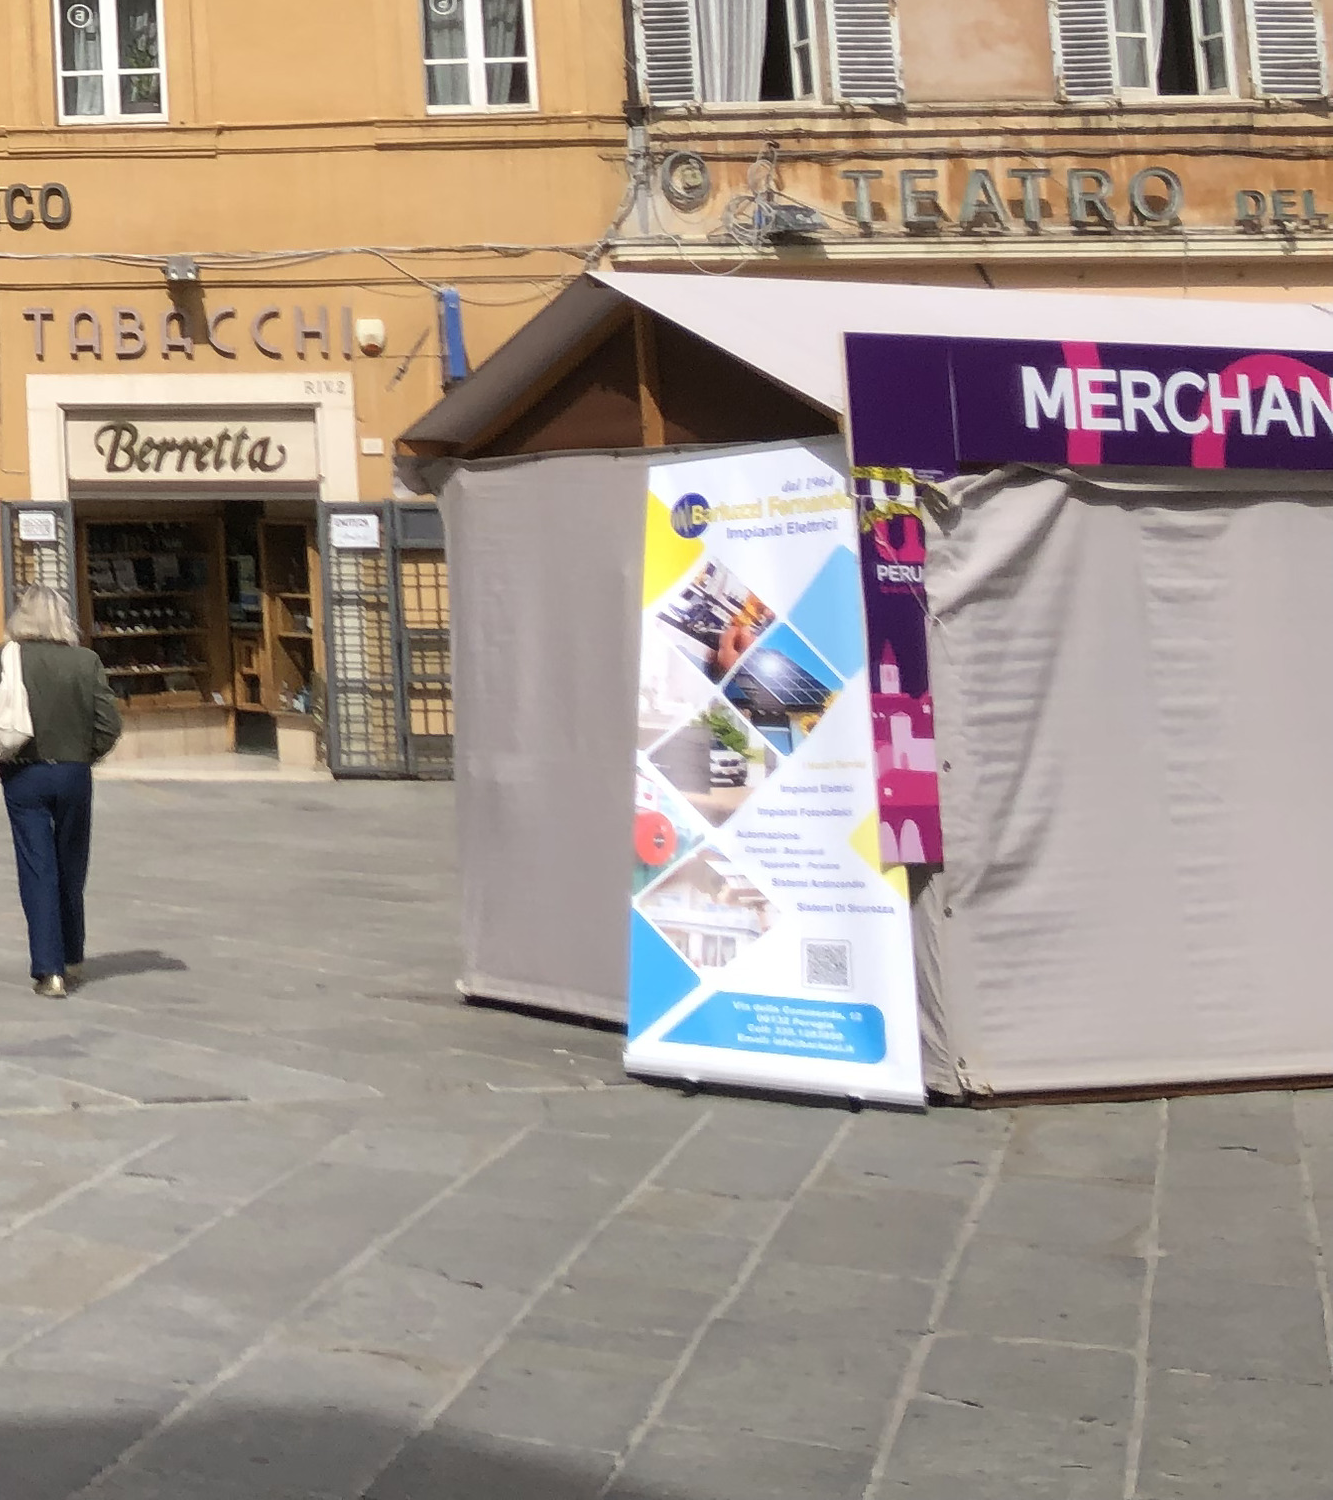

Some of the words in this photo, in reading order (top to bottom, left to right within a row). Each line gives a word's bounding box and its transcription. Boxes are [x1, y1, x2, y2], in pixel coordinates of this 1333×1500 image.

[841, 166, 1184, 227] TEATRO
[22, 305, 353, 362] TABACCHI
[1021, 365, 1333, 438] MERCHAN
[93, 420, 287, 474] Berretta
[726, 522, 783, 541] Impianti
[786, 516, 839, 535] Elettrici
[877, 564, 923, 582] PERU
